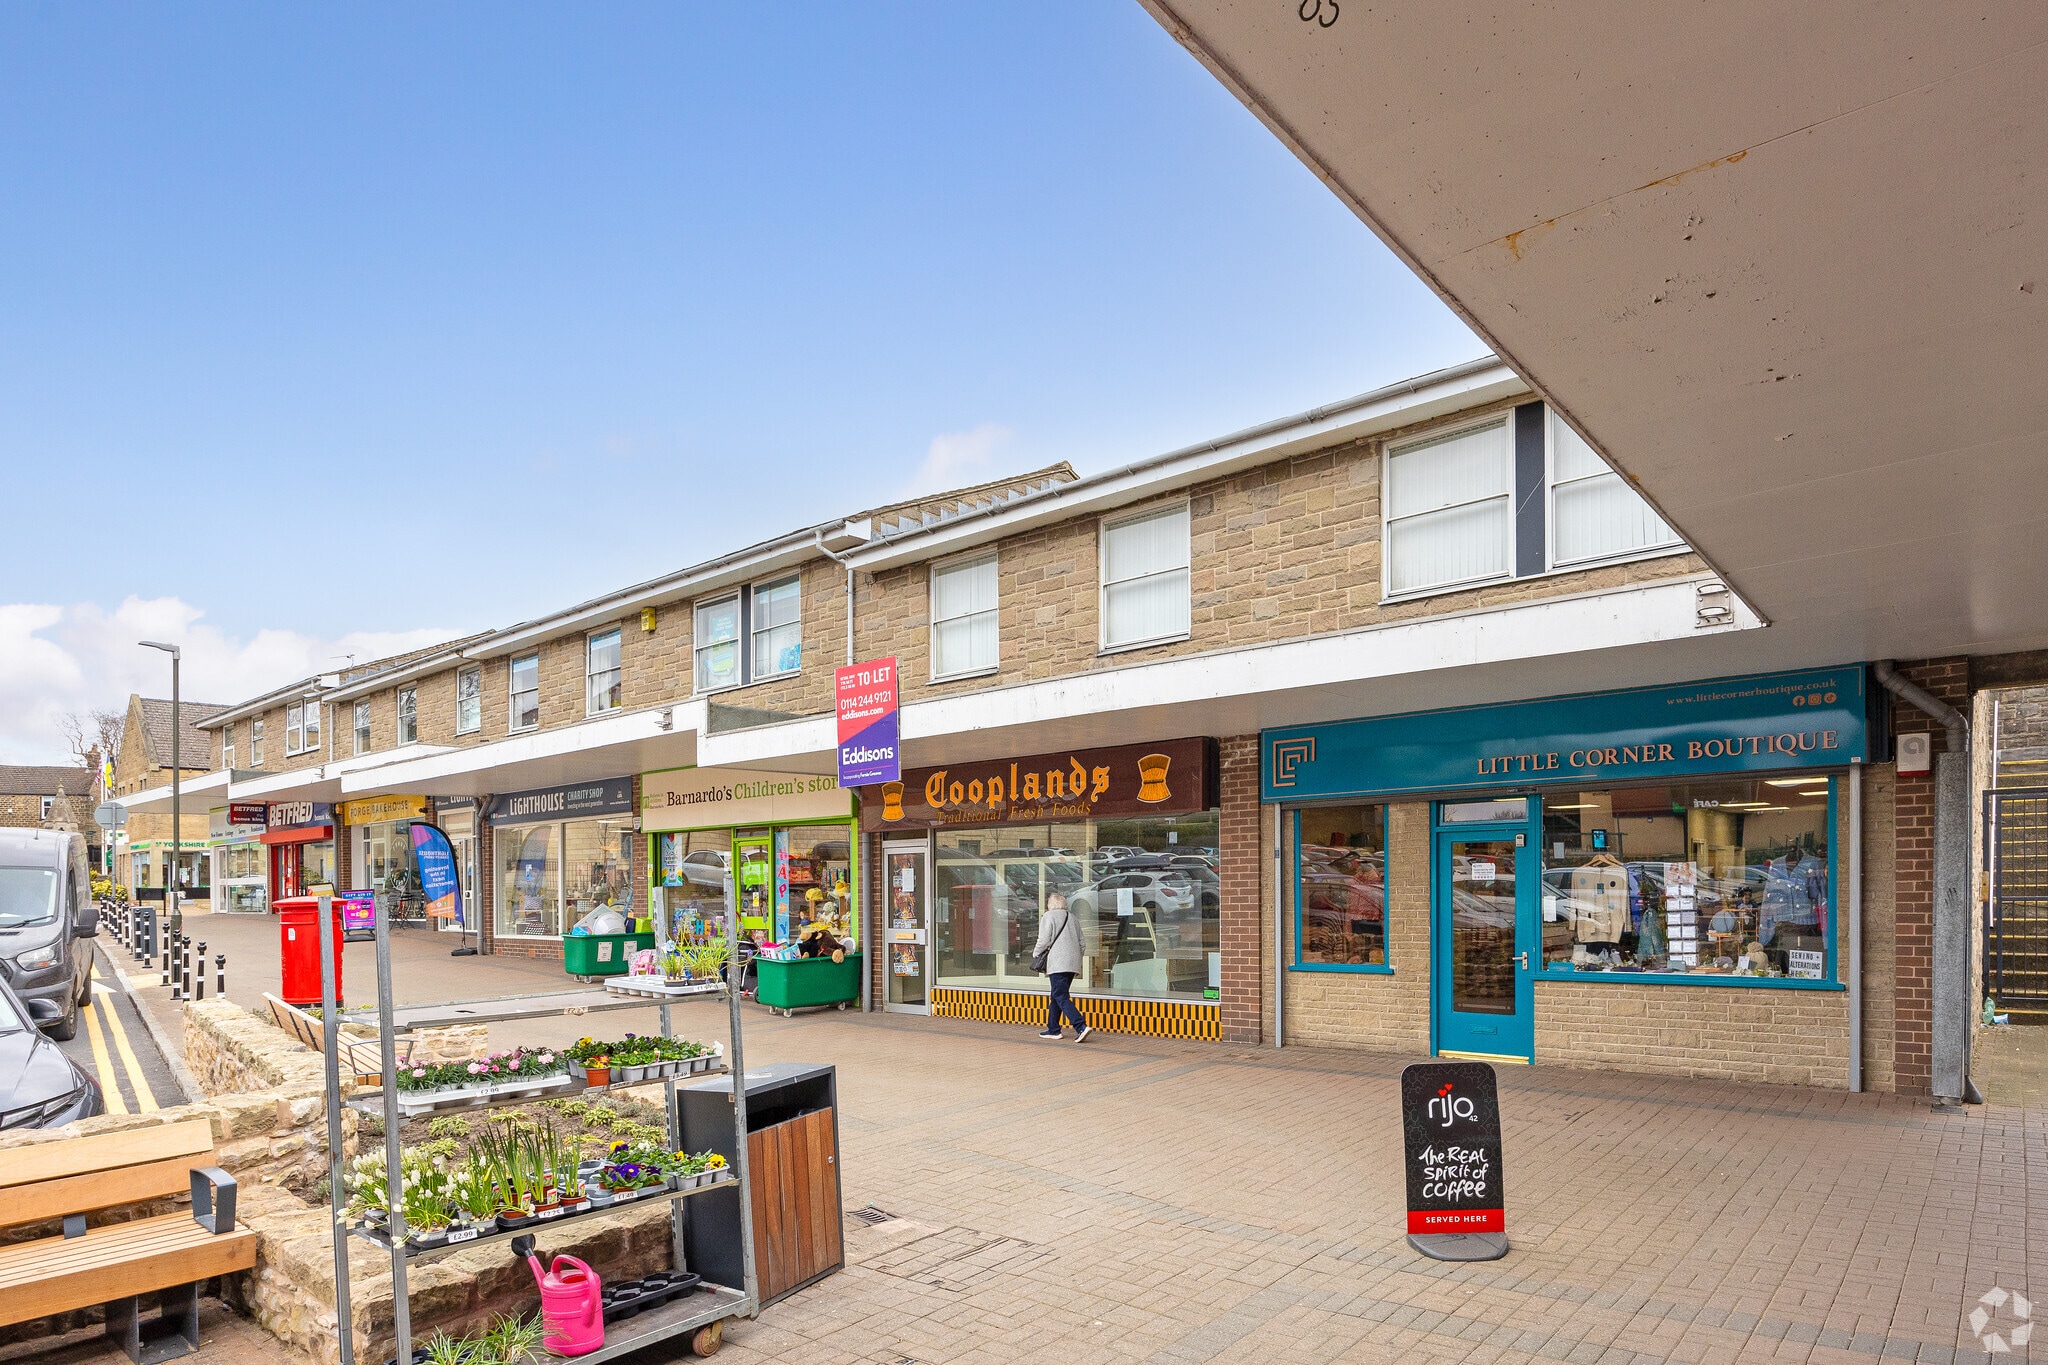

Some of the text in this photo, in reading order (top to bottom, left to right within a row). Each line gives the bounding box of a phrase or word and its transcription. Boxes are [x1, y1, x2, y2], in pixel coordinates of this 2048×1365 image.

[857, 671, 870, 686] TO
[873, 666, 891, 683] LET
[840, 690, 891, 710] 0114 244 9121
[1666, 678, 1837, 706] www.littlecornerboutique.co.uk
[841, 707, 884, 720] eddisons.com
[842, 746, 894, 766] Eddisons
[1477, 730, 1840, 776] LITTLE CORNER BOUTIQUE
[666, 775, 839, 807] Barnardo's Children's stor
[925, 756, 1111, 809] Cooplands
[567, 787, 604, 801] CHARITY SHOP
[269, 801, 314, 827] BETFRED
[936, 801, 1092, 825] Traditional Fresh Foods
[1789, 960, 1821, 970] ALTERATIONS
[1428, 1092, 1474, 1127] rijo
[1418, 1144, 1489, 1166] The REAL
[1472, 1163, 1489, 1181] of
[1425, 1215, 1488, 1224] SERVED HERE
[453, 1230, 474, 1241] £2.99
